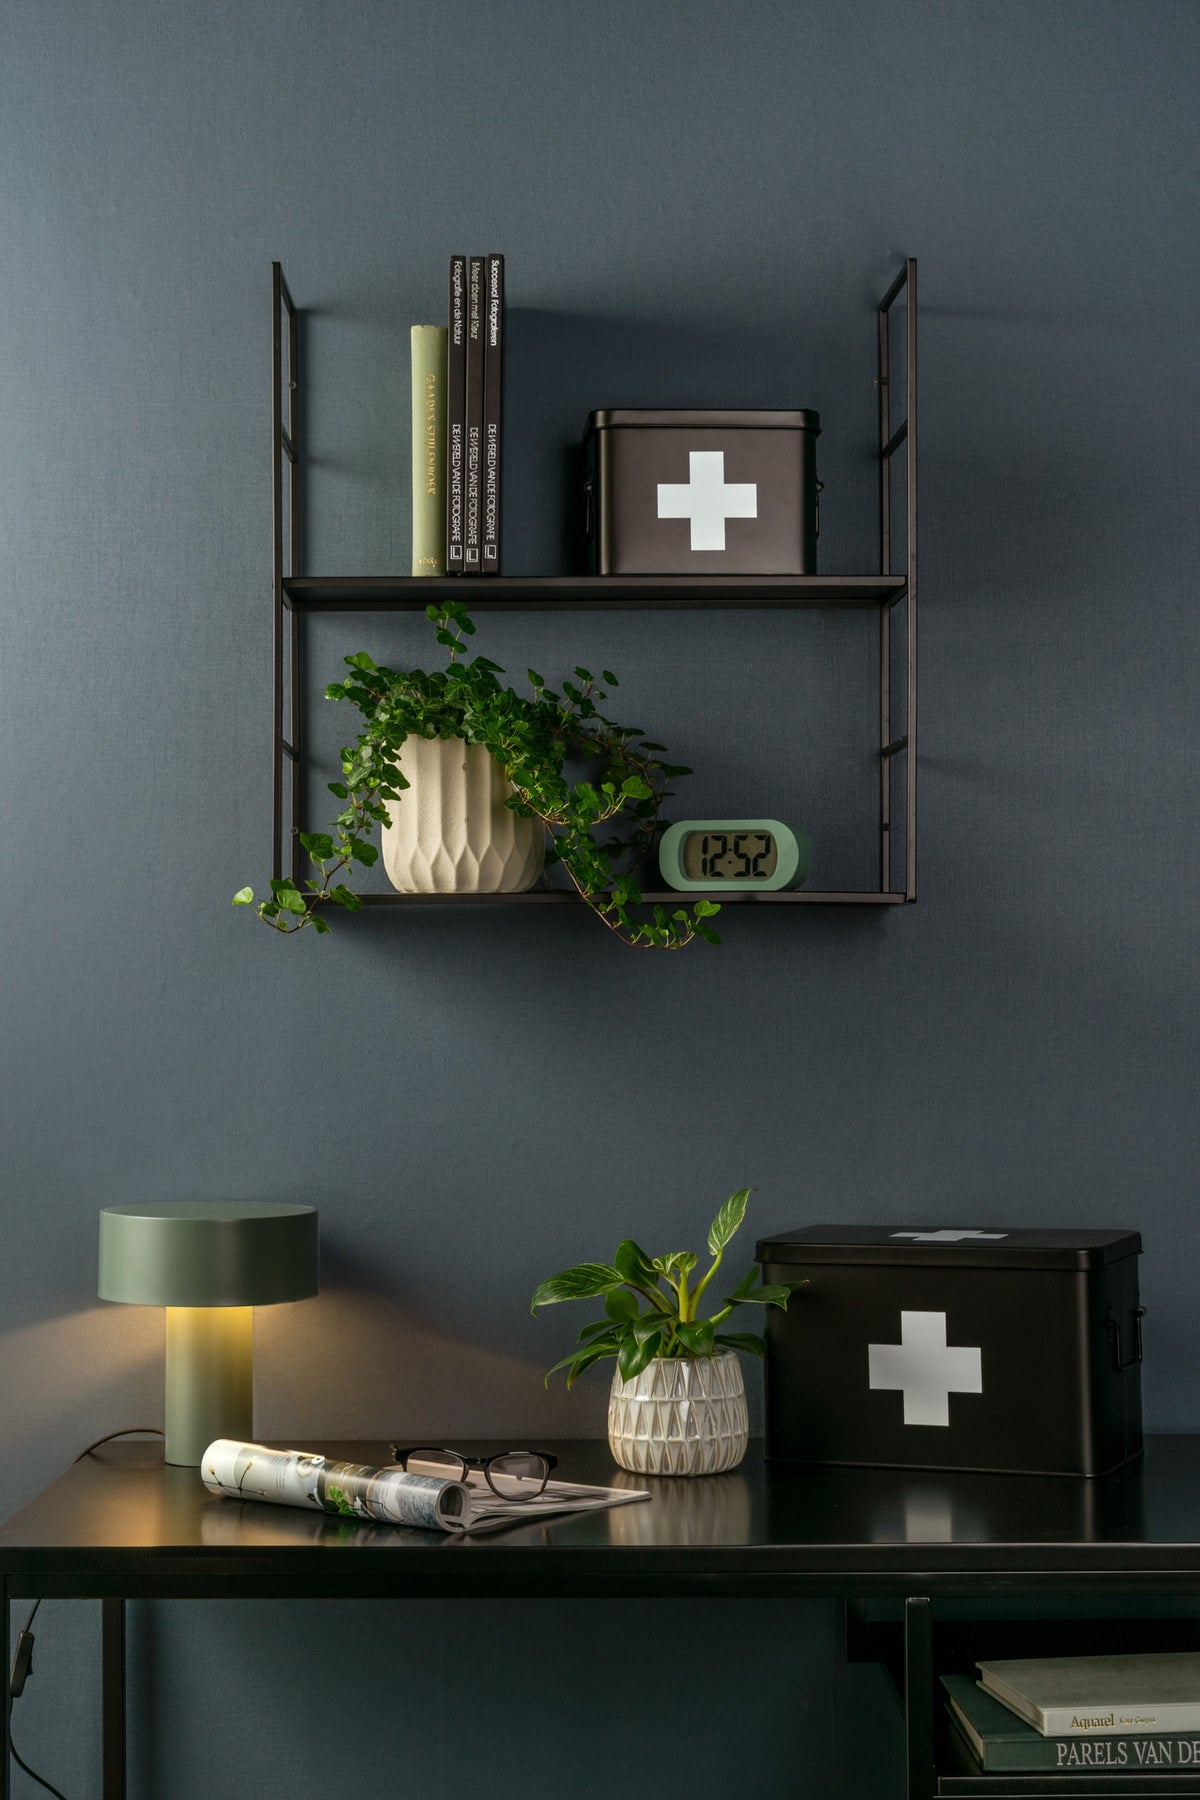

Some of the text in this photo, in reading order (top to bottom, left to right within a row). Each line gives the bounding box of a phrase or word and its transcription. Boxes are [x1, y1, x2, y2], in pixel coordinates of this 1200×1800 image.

[471, 262, 480, 283] Meer
[453, 261, 462, 345] Fotografie en de Natuur
[471, 284, 480, 304] doen
[471, 305, 480, 319] met
[490, 260, 500, 346] Succesvol Fotograferen
[452, 424, 461, 541] DE WERELD VAN DE FOTOGRAFIE
[468, 427, 479, 544] DE WERELD VAN DE FOTOGRAFIE
[486, 424, 497, 540] DE WERELD VAN DE FOTOGRAFIE
[702, 835, 771, 877] 12:52
[1070, 1713, 1116, 1731] Aquarel
[1056, 1742, 1128, 1766] PARELS
[1133, 1741, 1173, 1765] VAN
